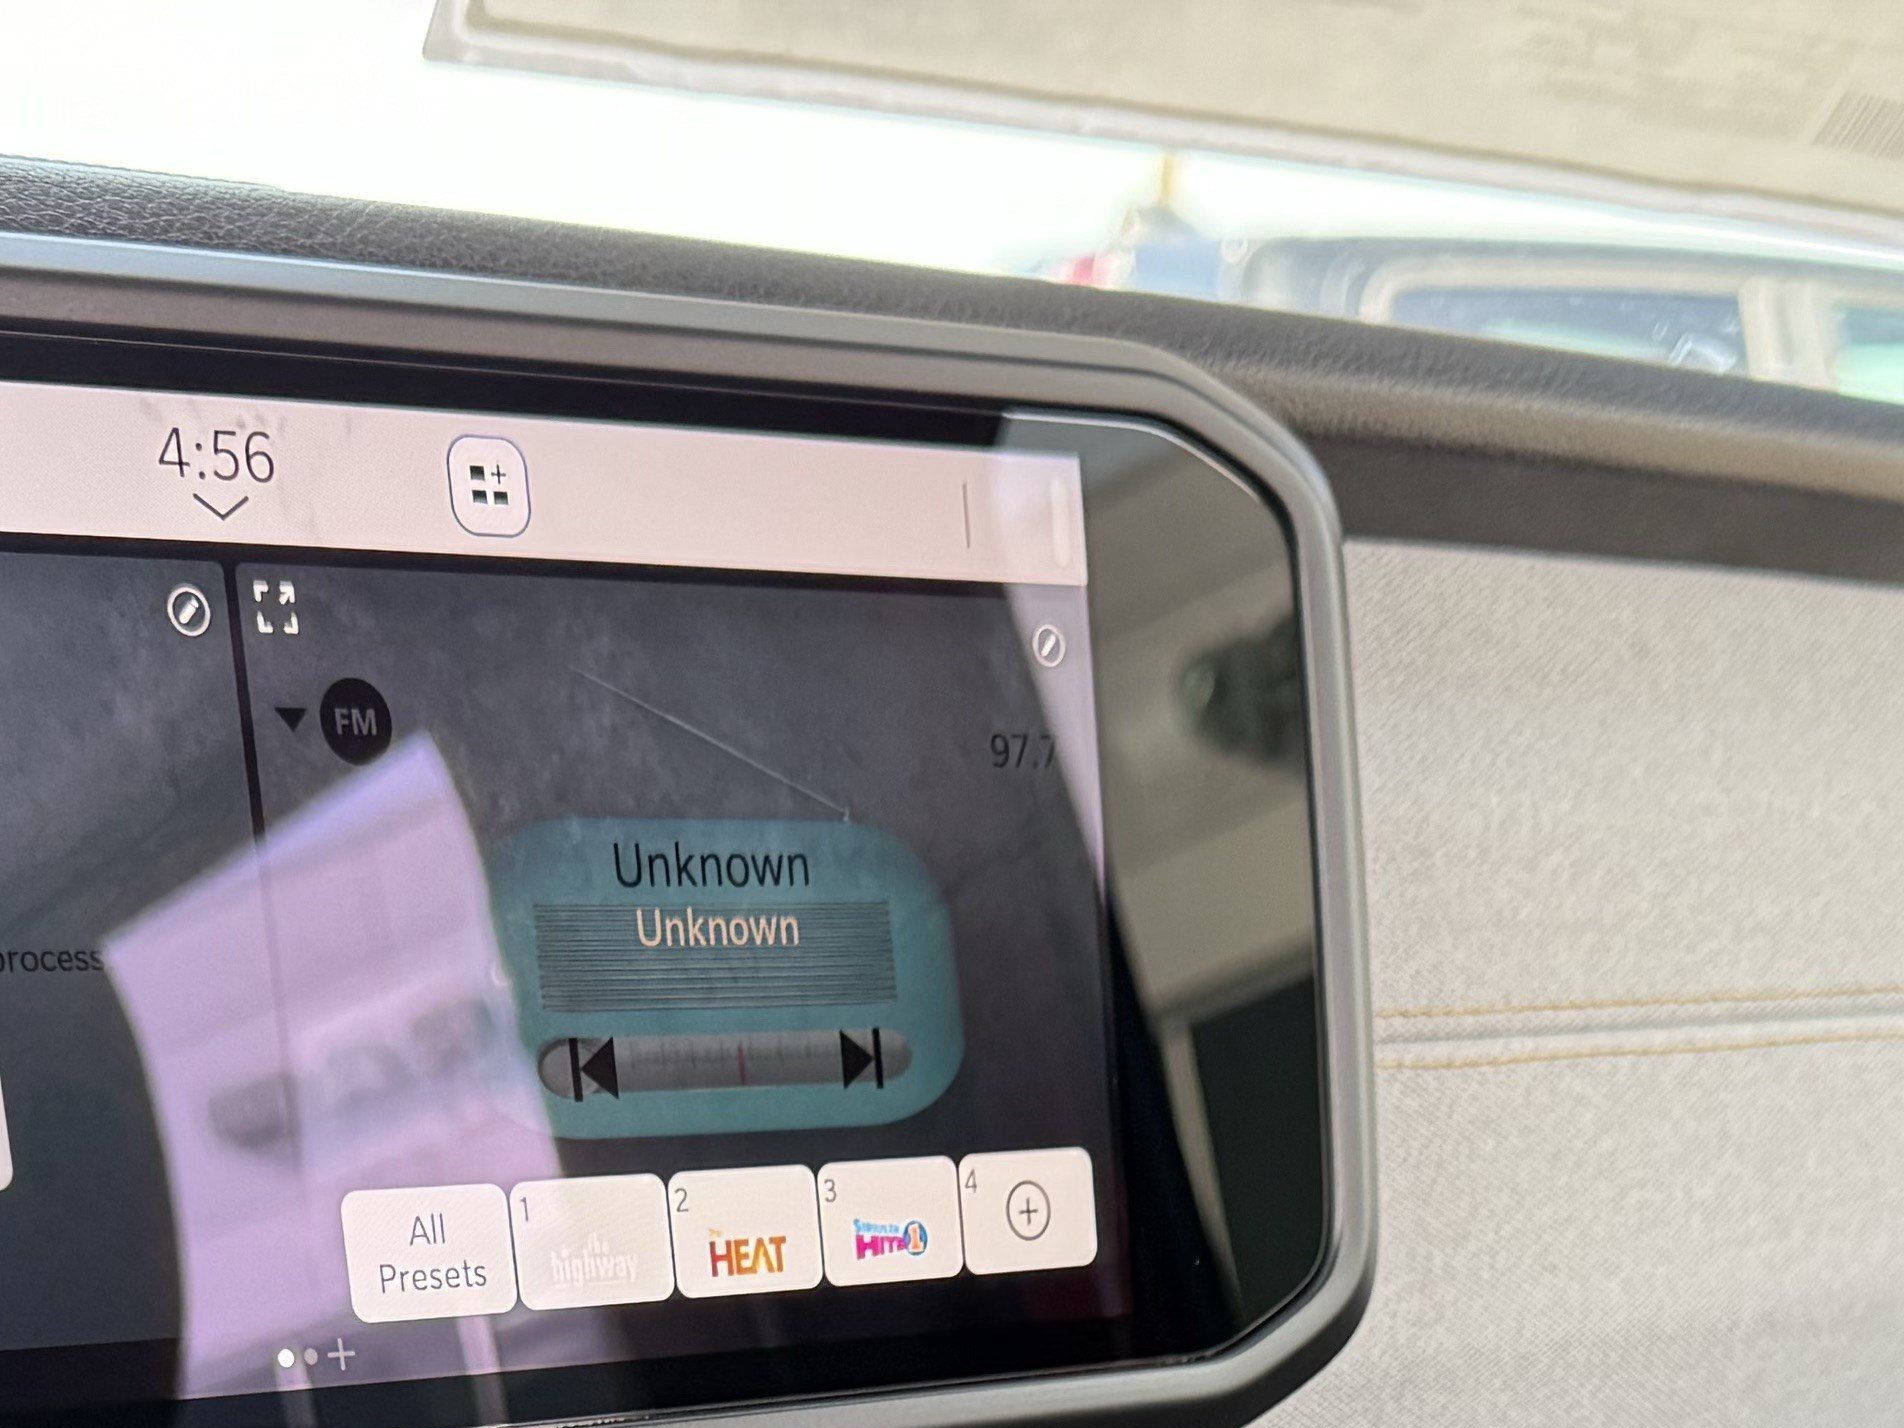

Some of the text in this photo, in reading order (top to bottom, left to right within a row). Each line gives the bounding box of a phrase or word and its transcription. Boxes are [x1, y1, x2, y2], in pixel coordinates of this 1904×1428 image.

[158, 427, 276, 484] 4:56
[334, 707, 379, 738] FM
[613, 841, 811, 890] Unknown
[636, 907, 801, 949] Unknown
[823, 1179, 839, 1204] 3
[964, 1169, 979, 1195] 4
[518, 1195, 531, 1223] 1
[674, 1188, 691, 1214] 2
[410, 1214, 447, 1247] All
[708, 1233, 788, 1279] HEAT
[378, 1259, 488, 1295] Presets
